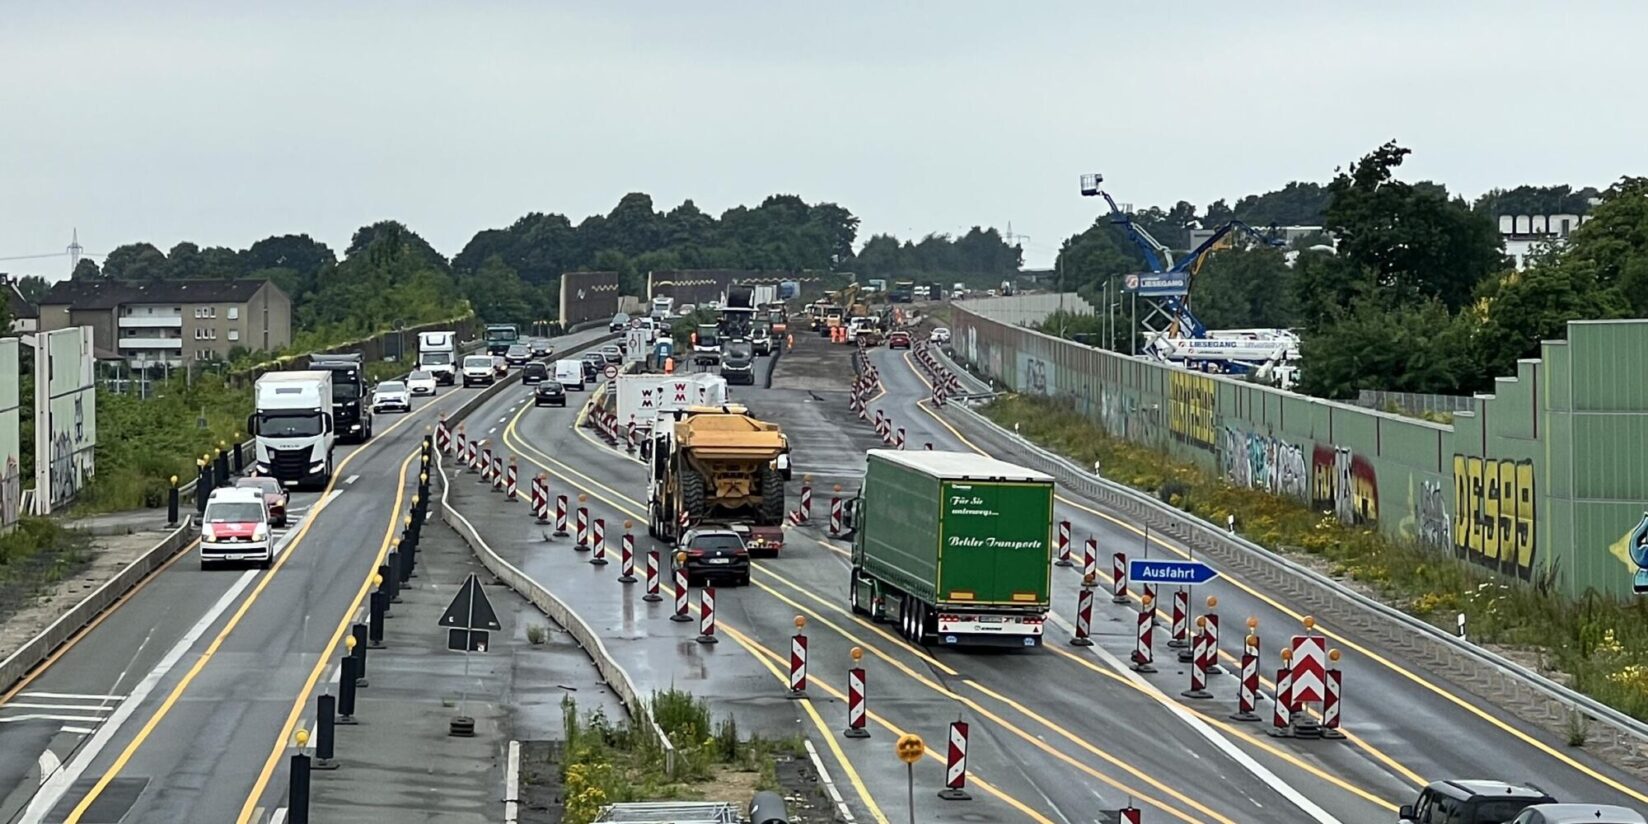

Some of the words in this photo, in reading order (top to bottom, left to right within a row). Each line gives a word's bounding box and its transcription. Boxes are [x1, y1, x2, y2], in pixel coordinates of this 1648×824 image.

[950, 496, 969, 506] Für
[970, 496, 983, 505] Sie
[985, 537, 1042, 550] Transporte
[1142, 566, 1195, 579] Ausfahrt
